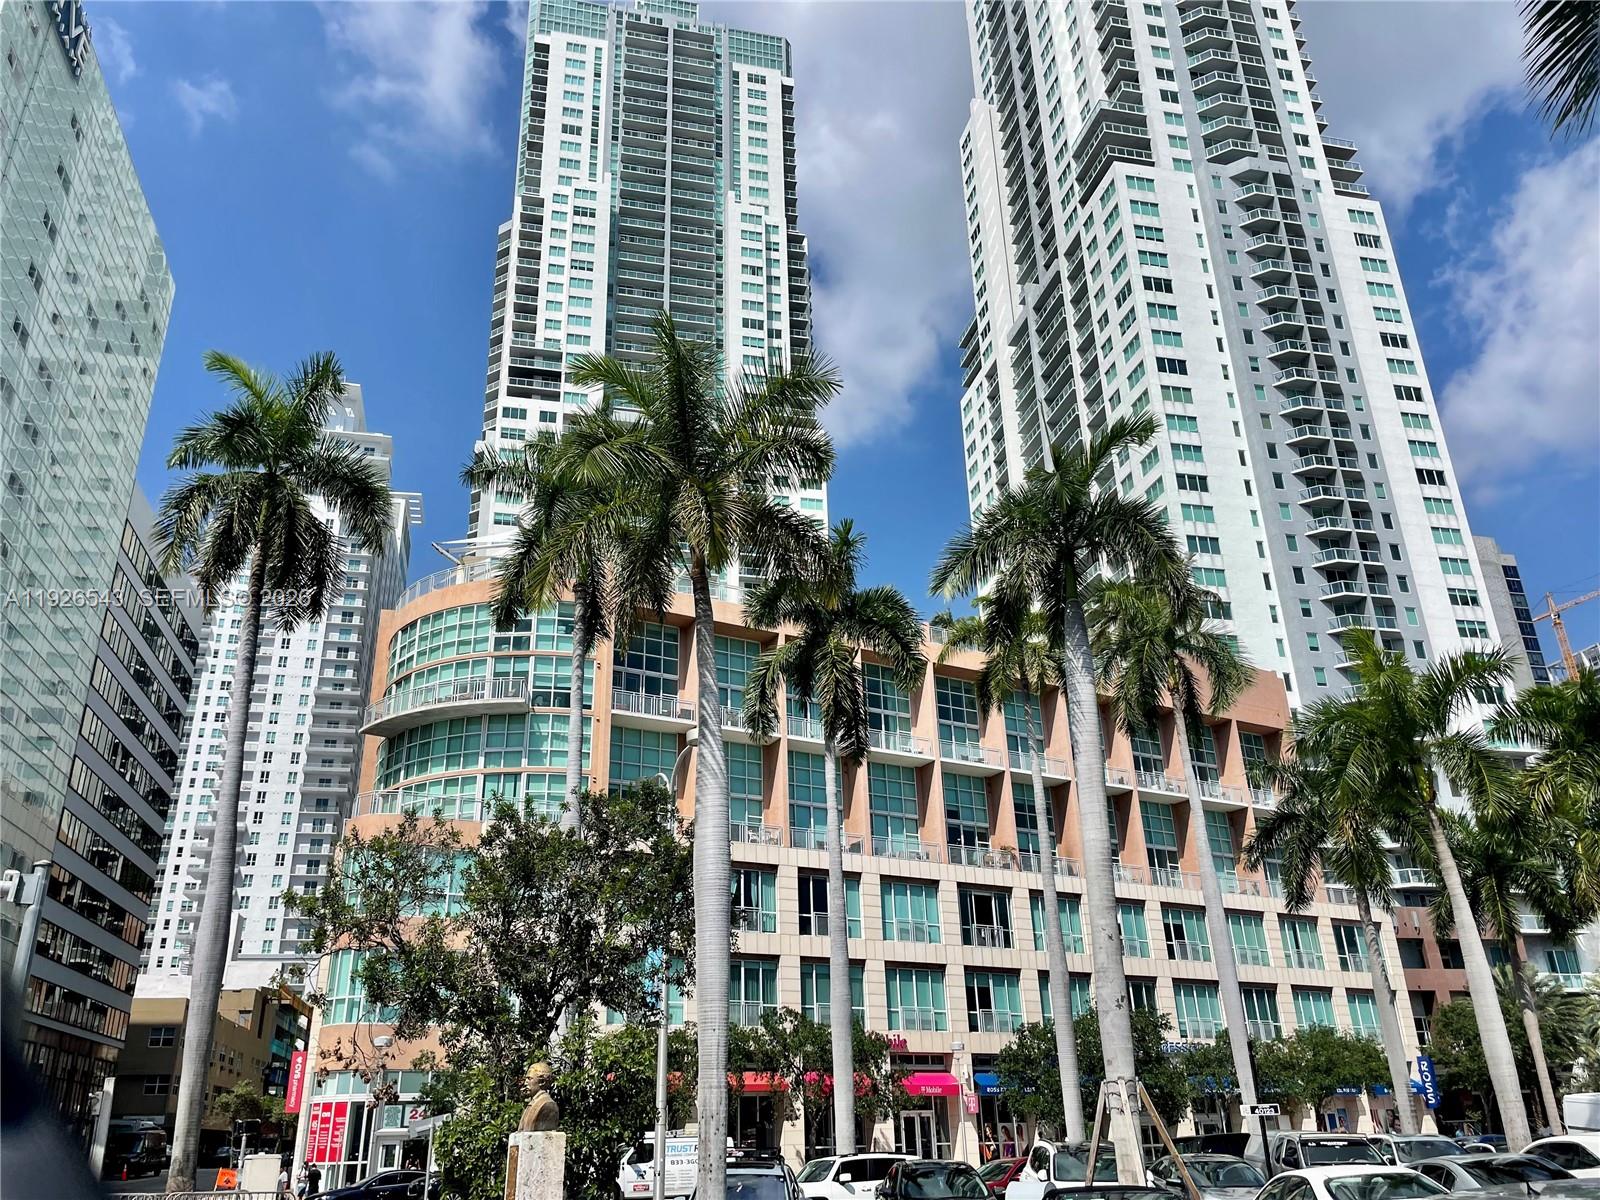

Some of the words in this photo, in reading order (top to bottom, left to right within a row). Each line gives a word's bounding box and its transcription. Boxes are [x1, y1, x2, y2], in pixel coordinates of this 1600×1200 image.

[1420, 1061, 1436, 1104] ROSS
[289, 1080, 299, 1108] pharmacy
[968, 1096, 976, 1112] T
[666, 1144, 693, 1153] TRUST
